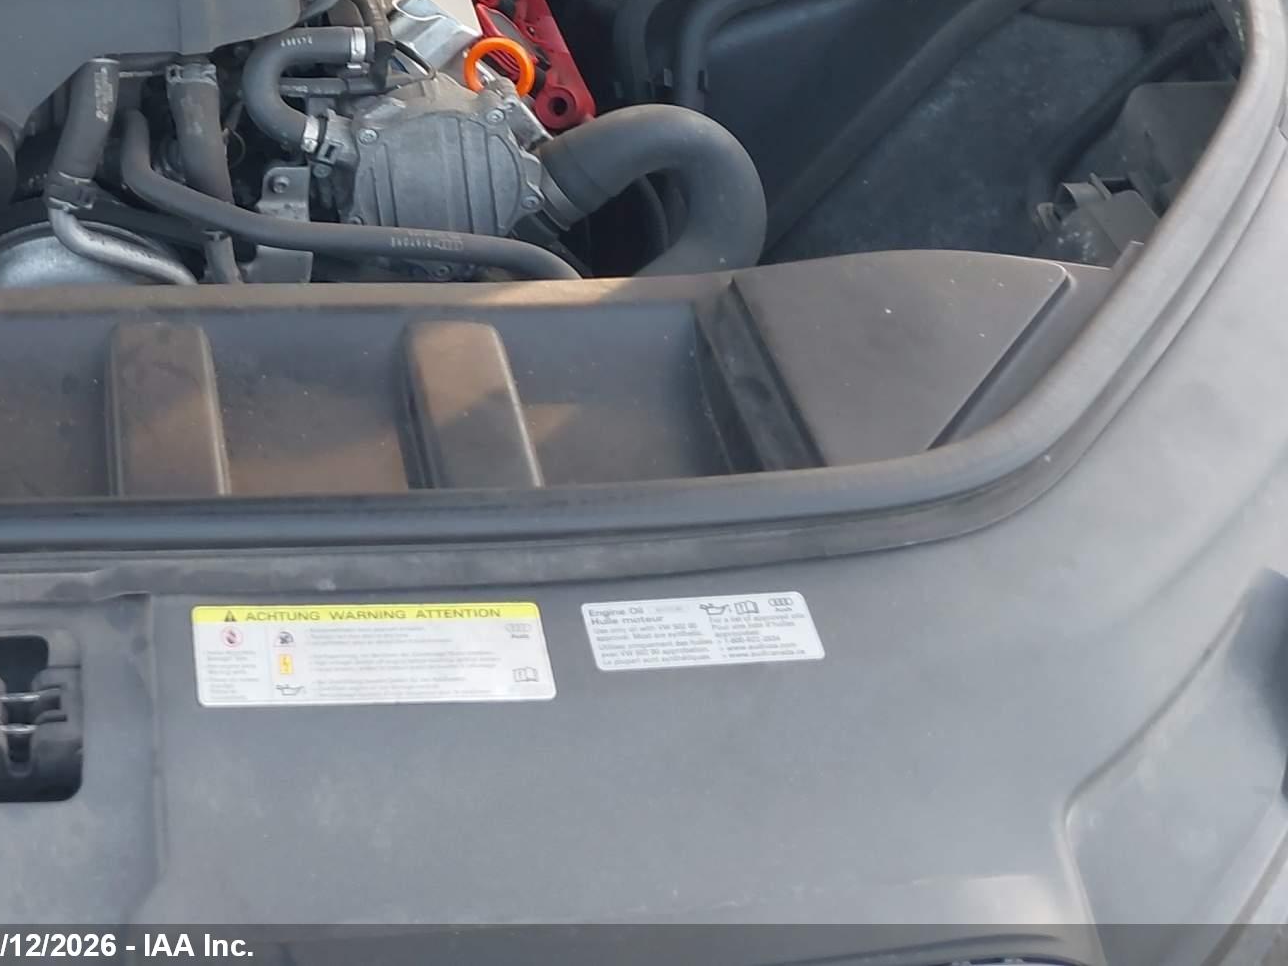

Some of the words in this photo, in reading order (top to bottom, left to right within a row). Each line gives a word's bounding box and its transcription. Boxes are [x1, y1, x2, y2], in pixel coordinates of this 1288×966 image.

[245, 611, 320, 621] ACHTUNG
[329, 609, 406, 620] WARNING
[416, 608, 501, 618] ATTENTION
[589, 609, 625, 617] Engine
[629, 606, 644, 614] Oil
